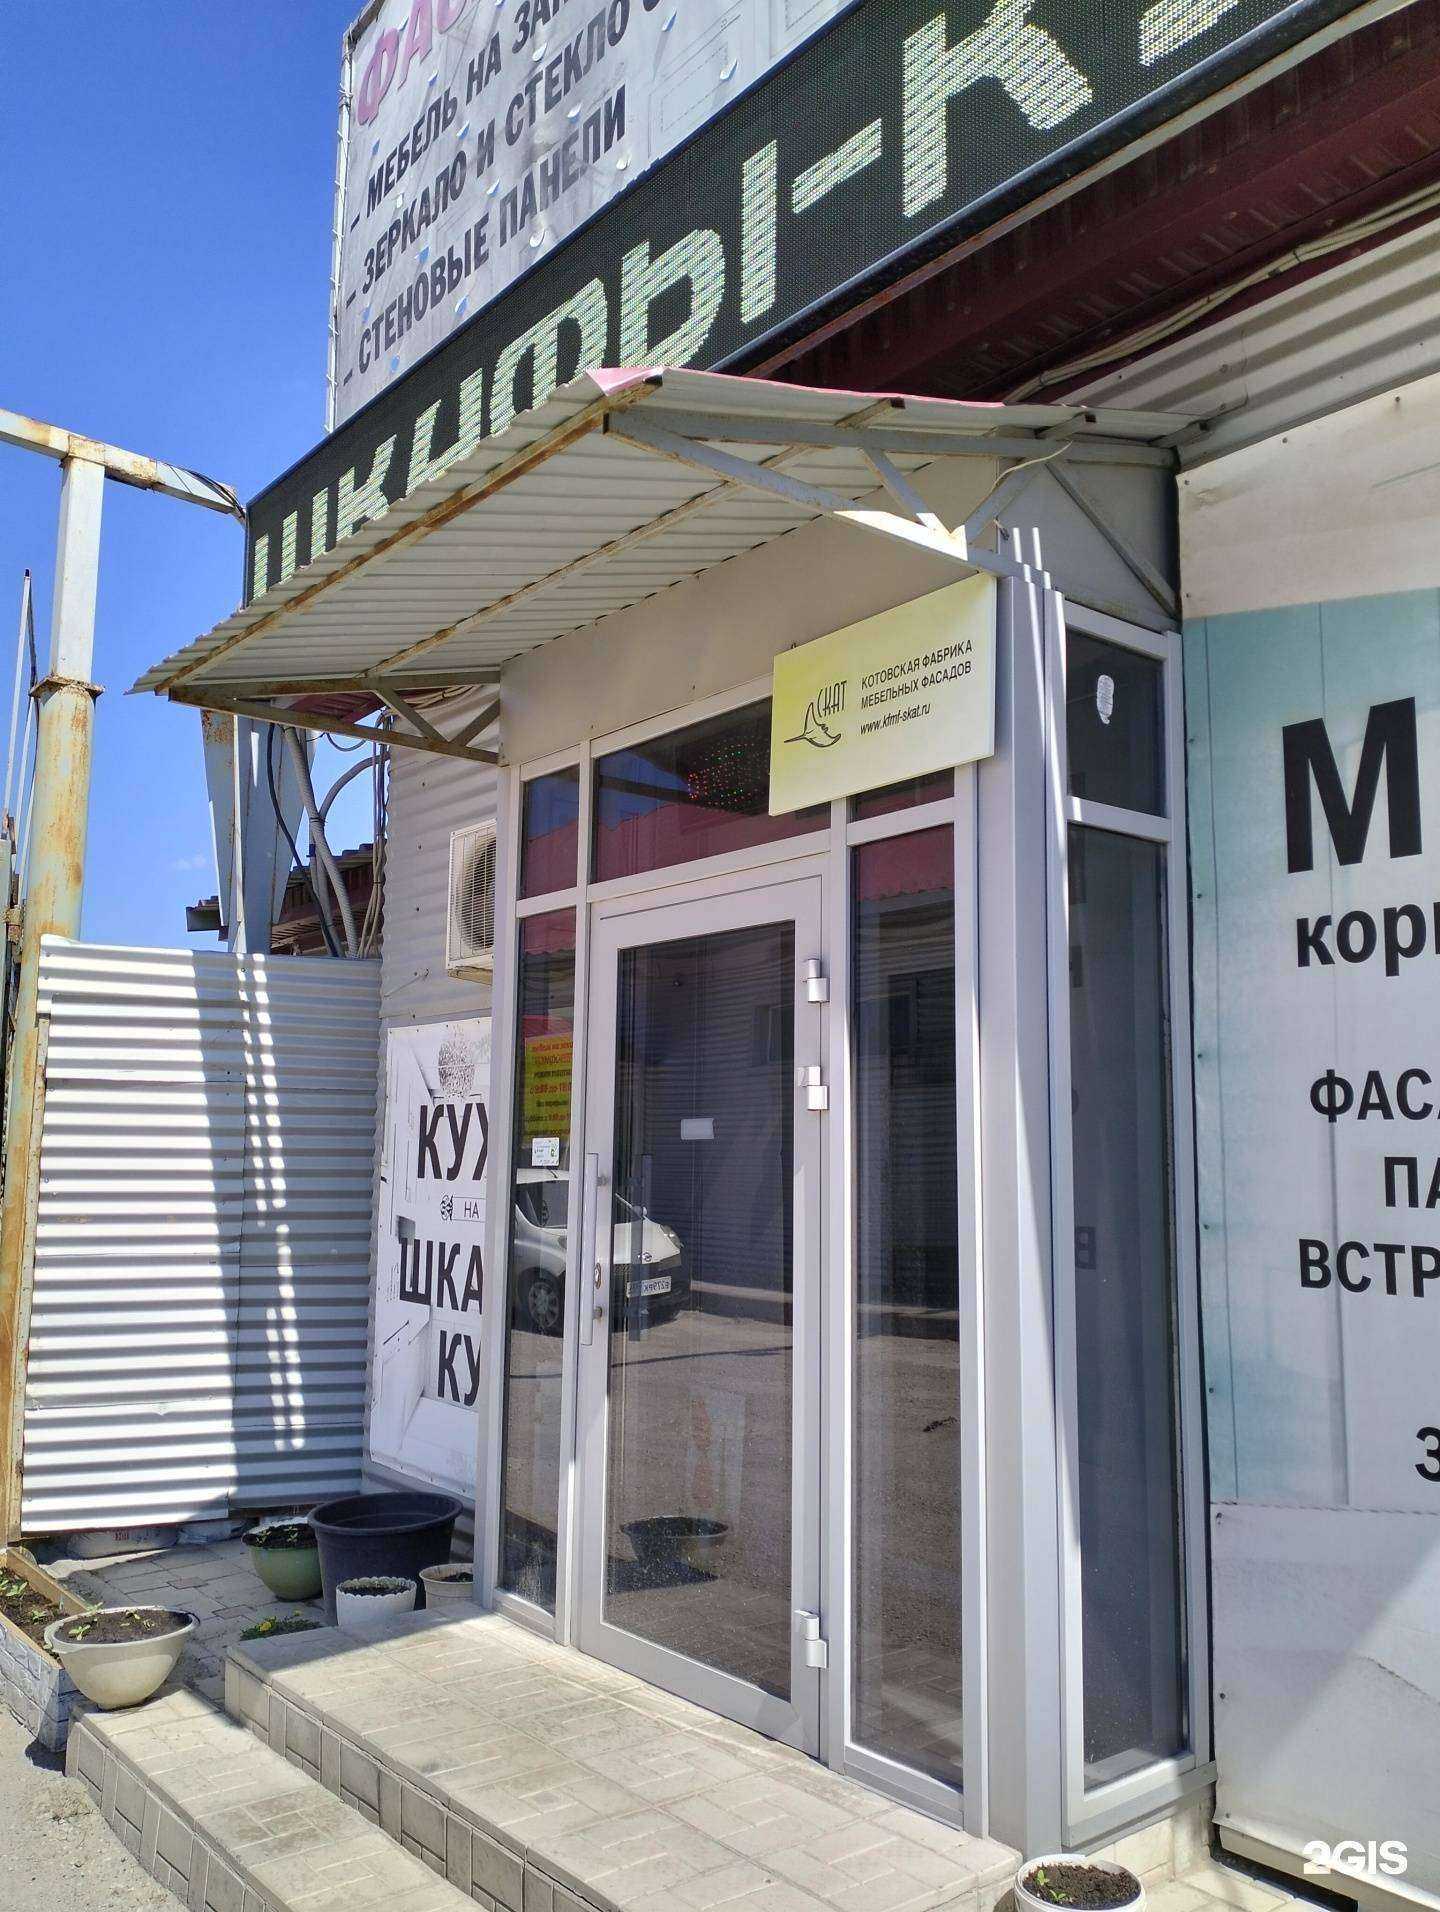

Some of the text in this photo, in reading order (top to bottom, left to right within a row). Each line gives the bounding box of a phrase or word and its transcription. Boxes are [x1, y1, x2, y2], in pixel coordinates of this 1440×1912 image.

[362, 150, 467, 295] ЗЕРКАЛО
[477, 118, 496, 179] И
[505, 0, 630, 146] СТЕКЛО
[366, 87, 459, 219] МЕБЕЛЬ
[466, 32, 502, 106] НА
[358, 212, 490, 374] СТЕНОВЫЕ
[499, 84, 626, 248] ПАНЕЛИ
[861, 639, 973, 690] КОТОВСКАЯ ФАБРИКА
[861, 660, 972, 710] МЕБЕЛЬНЫХ ФАСАДОВ
[860, 702, 931, 735] www.kfmf-skat.ru
[1310, 1069, 1440, 1123] ФАС
